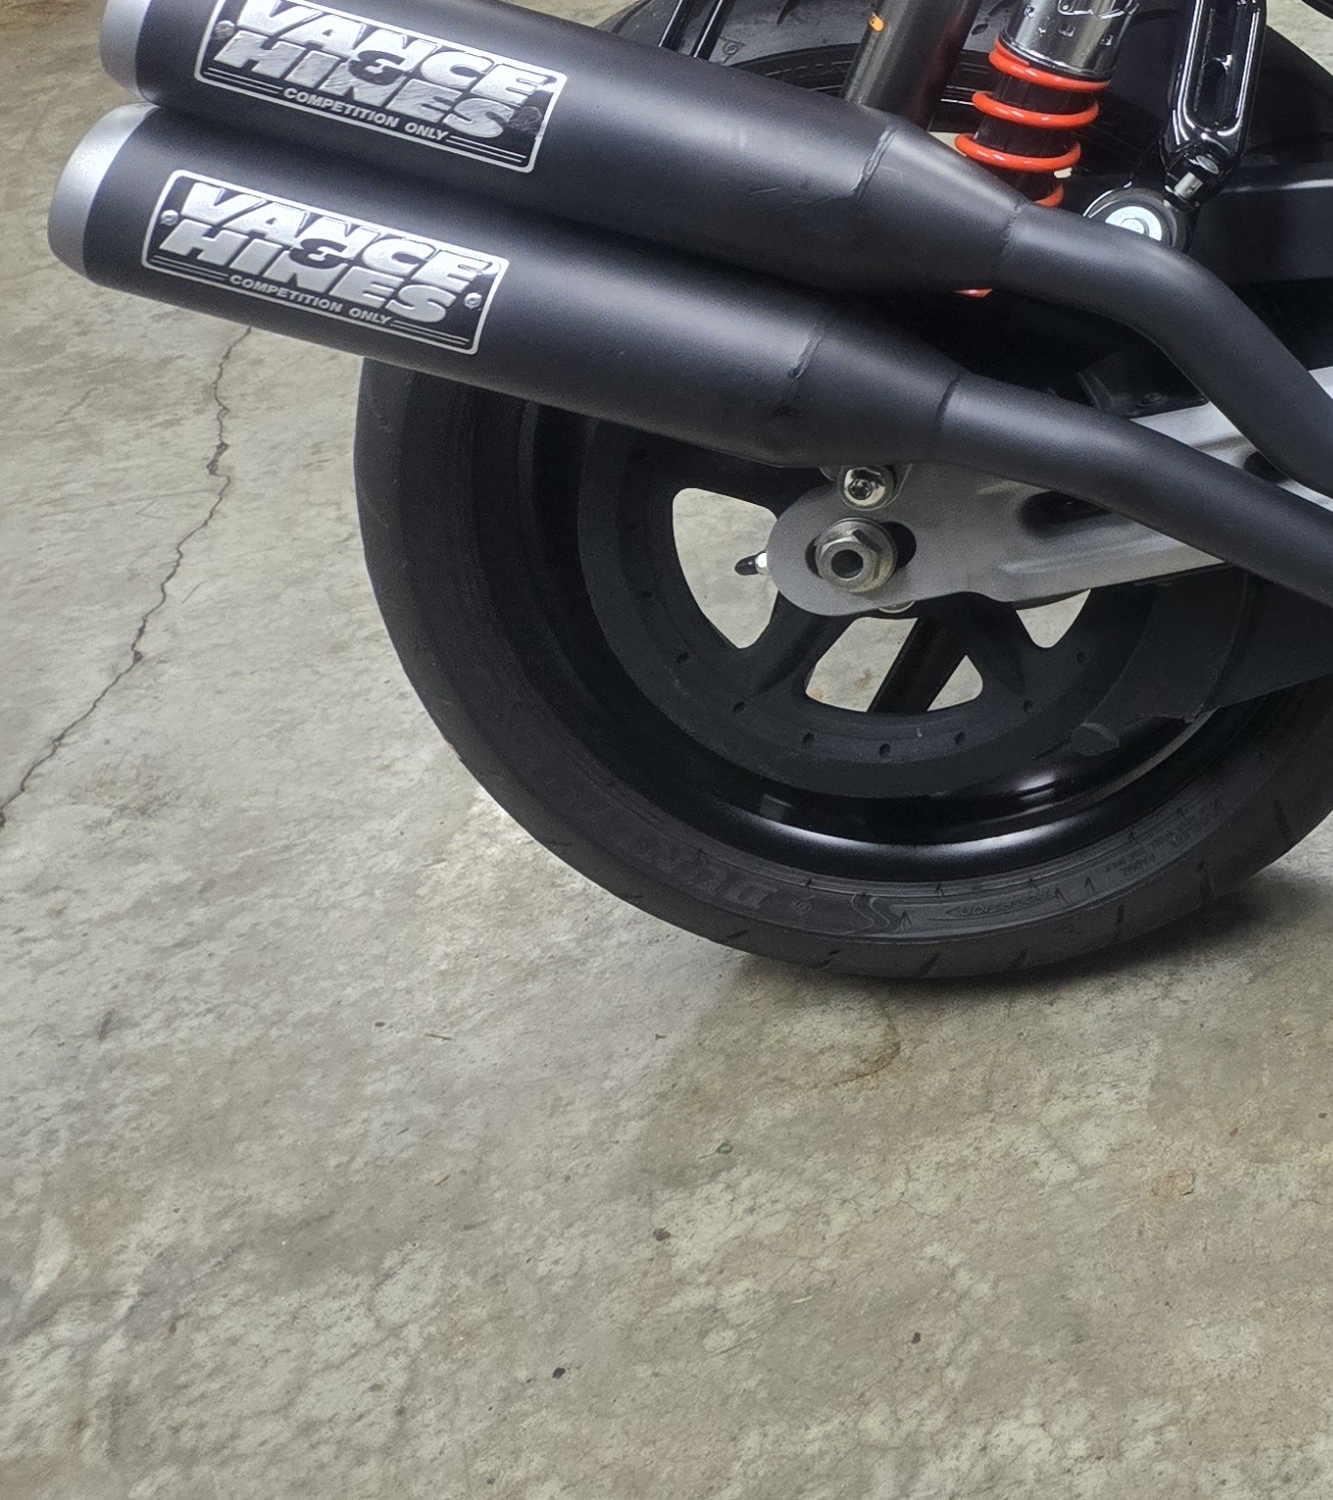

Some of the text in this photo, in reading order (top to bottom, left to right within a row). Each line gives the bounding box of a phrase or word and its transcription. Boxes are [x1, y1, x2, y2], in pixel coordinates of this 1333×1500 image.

[213, 30, 516, 138] HINES
[283, 86, 449, 142] COMPETITION ONLY
[158, 219, 457, 324] HINES
[181, 182, 496, 293] VANCE
[228, 273, 393, 326] COMPETITION ONLY
